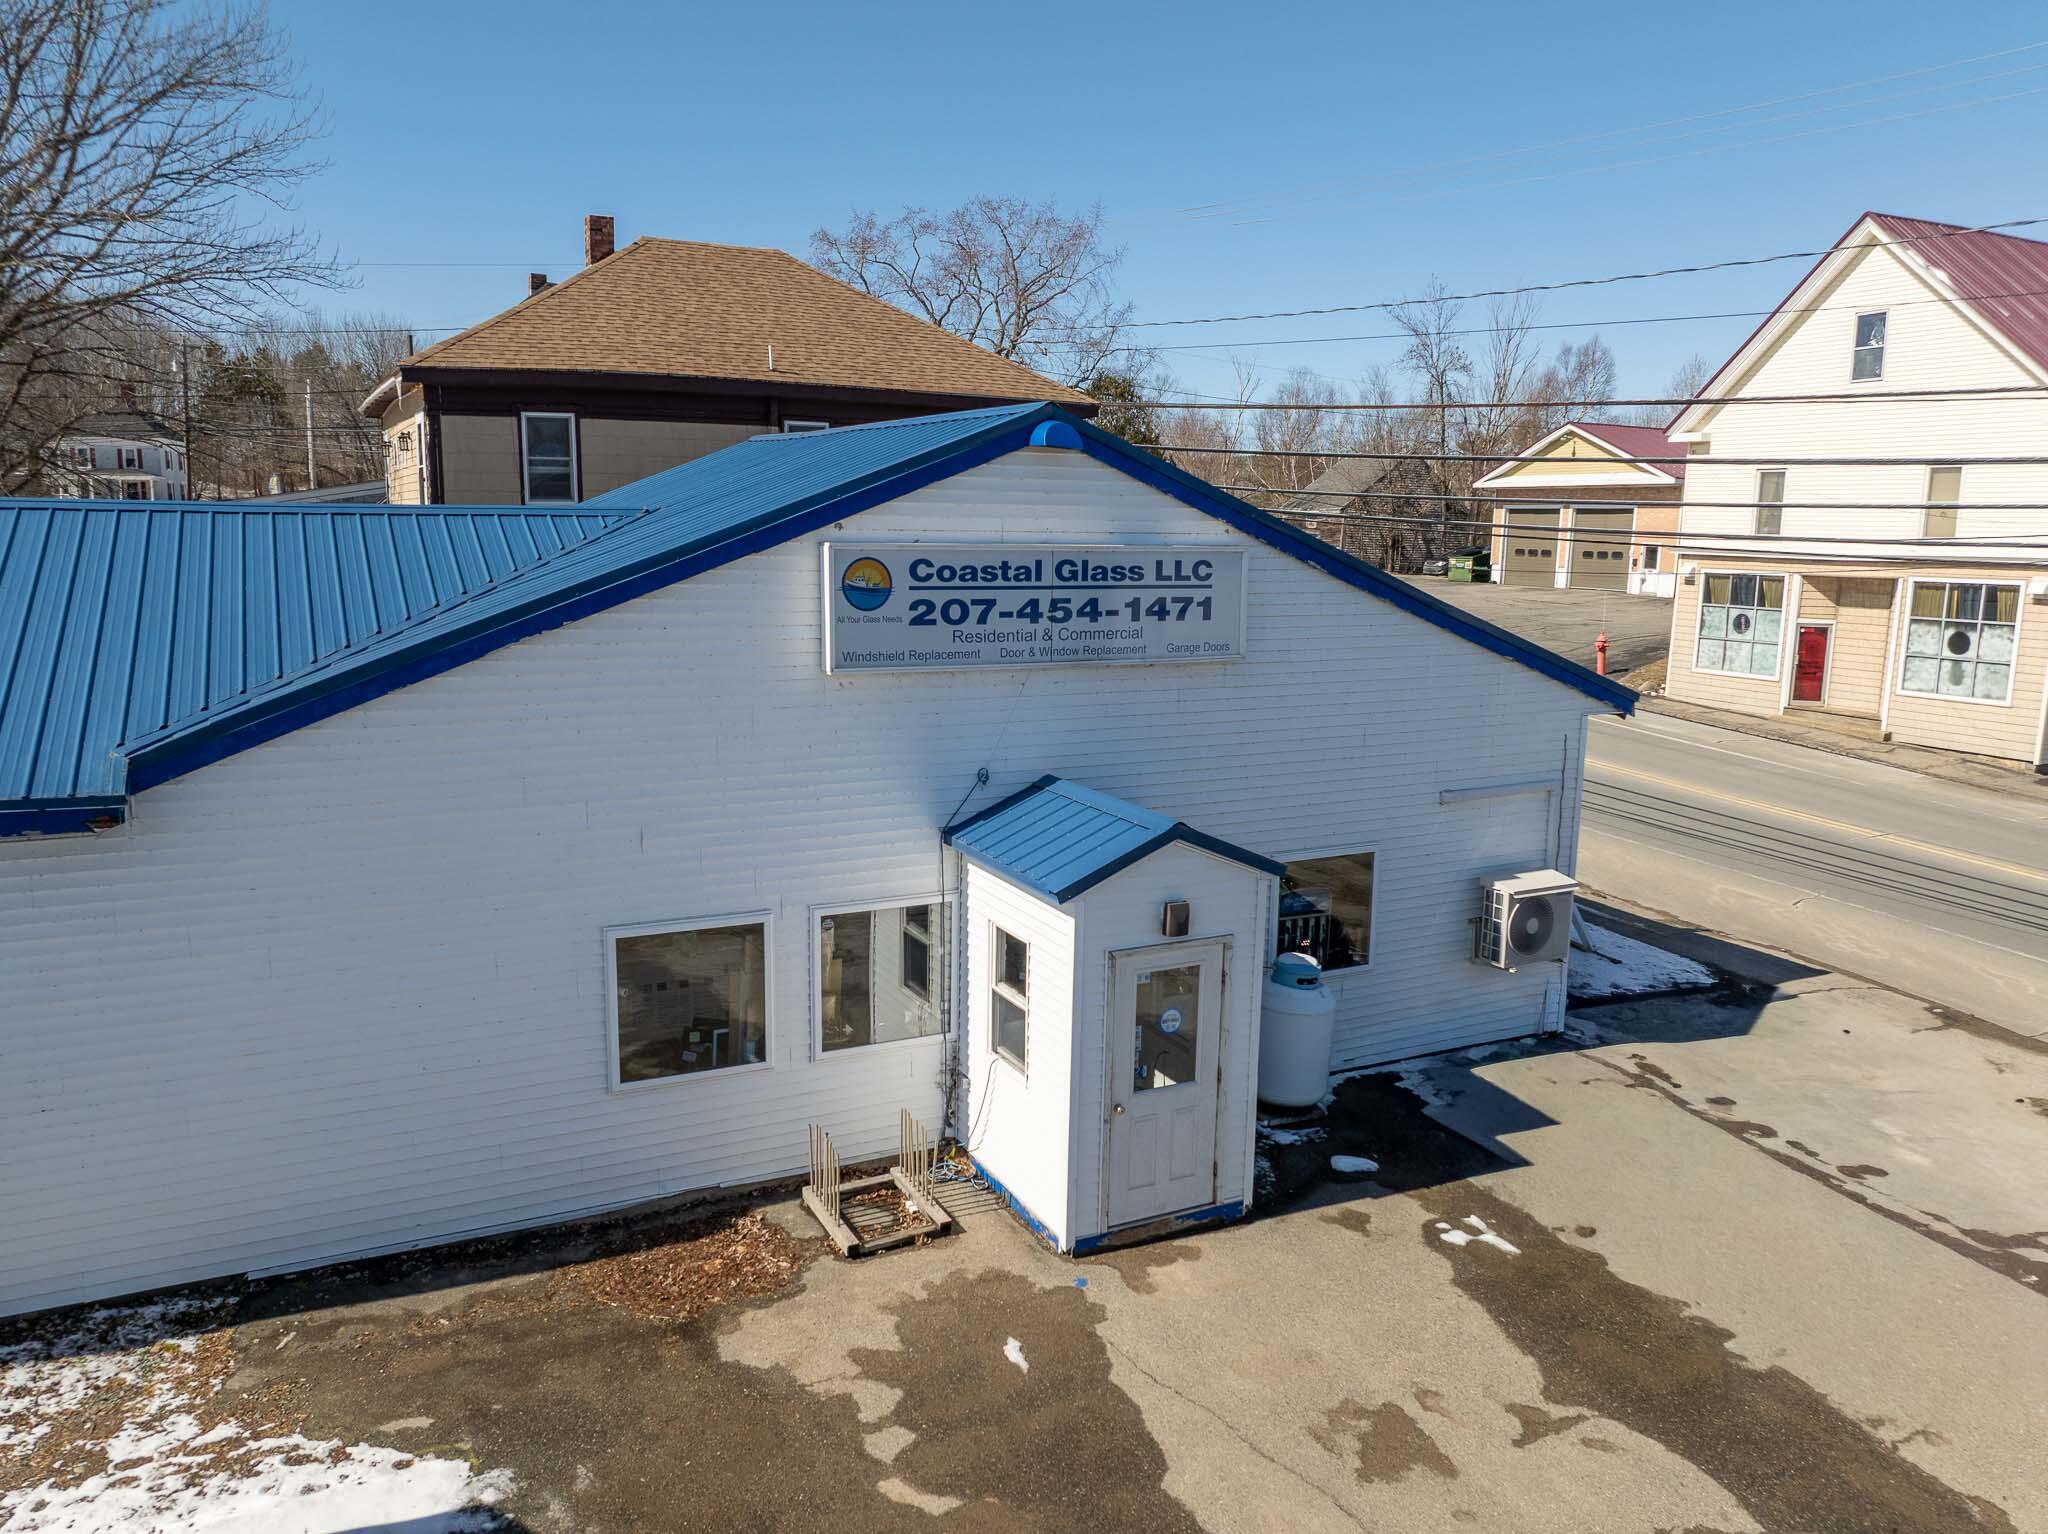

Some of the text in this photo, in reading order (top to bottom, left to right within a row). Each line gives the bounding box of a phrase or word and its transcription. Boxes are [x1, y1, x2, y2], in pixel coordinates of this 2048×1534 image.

[909, 558, 1214, 582] Coastal Glass LLC
[908, 596, 1213, 626] 207-454-1471
[952, 626, 1143, 644] Residential & Commercial
[842, 649, 981, 662] Windshield Replacement
[1000, 644, 1147, 658] Door & Window Replacement
[1166, 641, 1231, 655] Garage Doors
